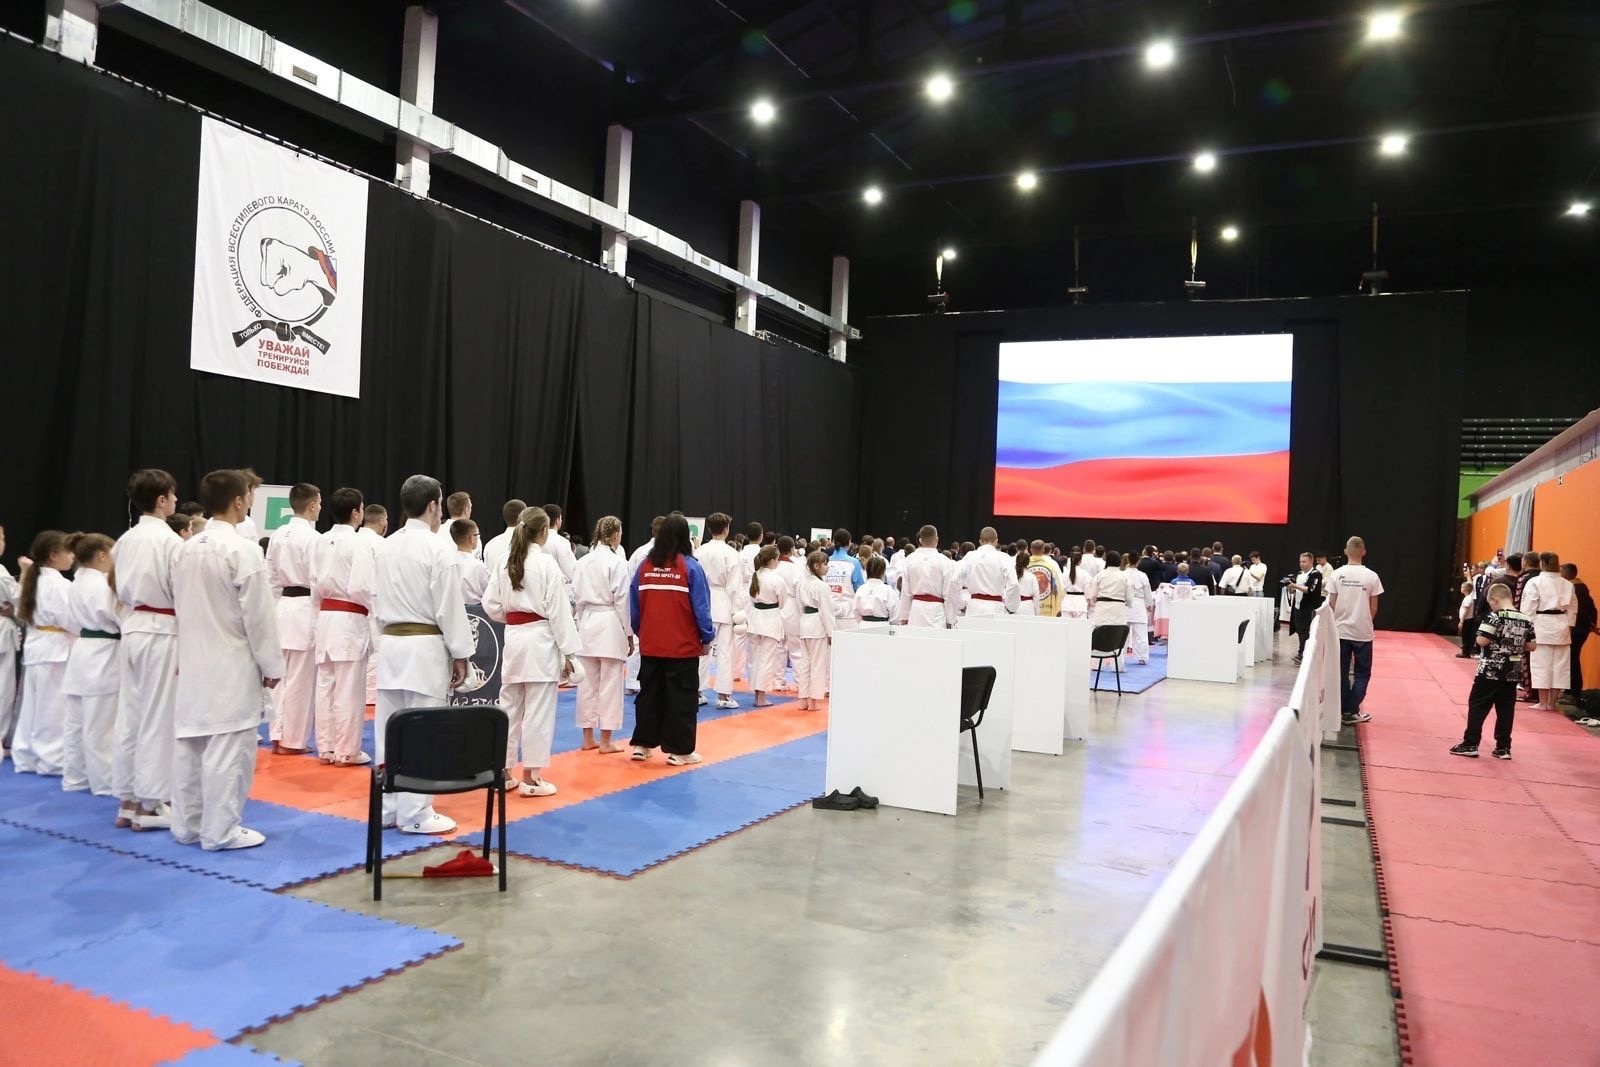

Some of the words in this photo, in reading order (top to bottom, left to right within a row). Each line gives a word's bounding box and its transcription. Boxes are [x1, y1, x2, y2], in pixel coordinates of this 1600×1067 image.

[277, 196, 310, 216] КАРАТЭ
[228, 195, 275, 253] ВСЕСТИЛЕВОГО
[310, 214, 336, 254] РОССИИ
[228, 256, 262, 318] ФЕДЕРАЦИЯ
[239, 323, 262, 340] ТОЛЬКО
[258, 338, 310, 359] УВАЖАЙ
[258, 350, 310, 367] ТРЕНИРУЙСЯ
[257, 359, 310, 376] ПОБЕЖДАЙ
